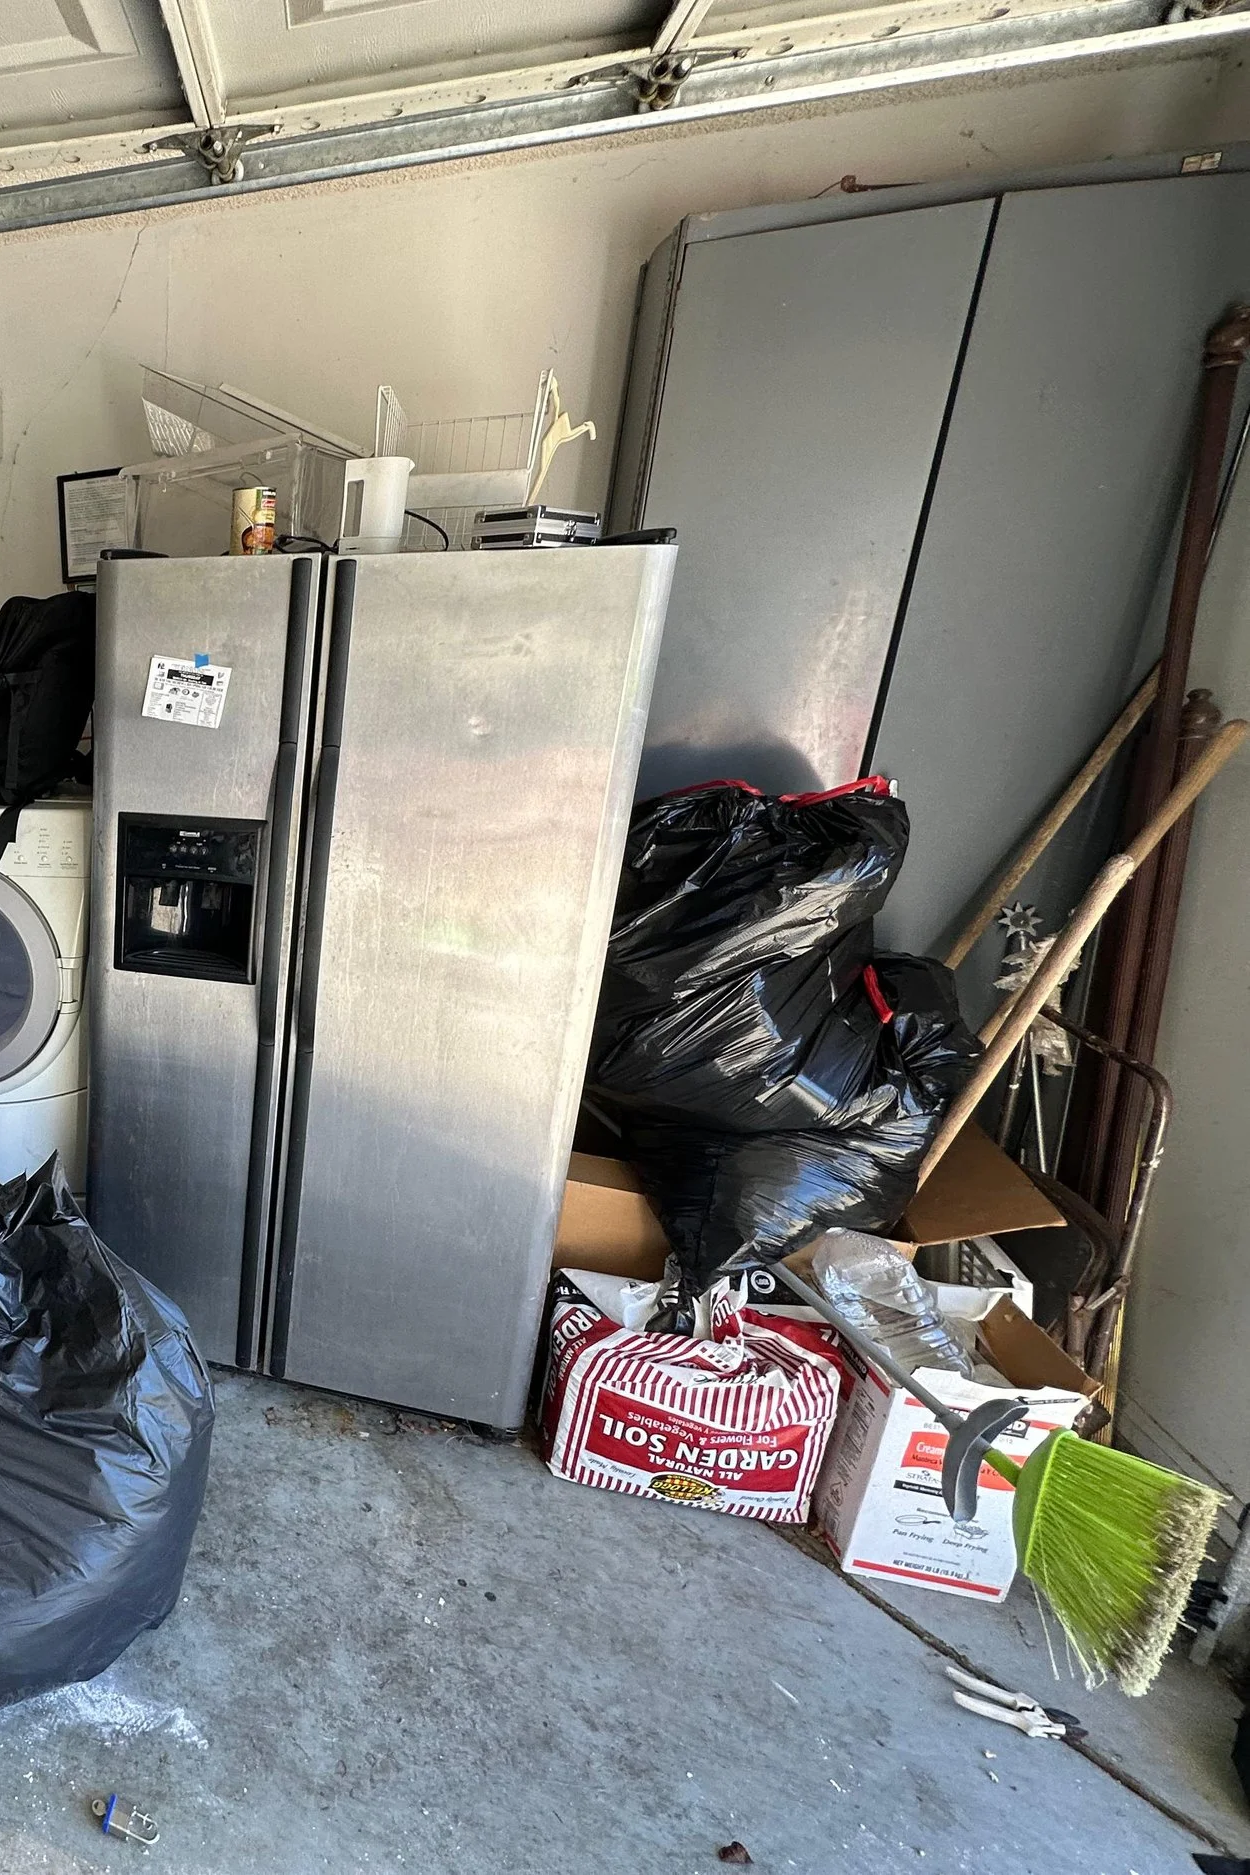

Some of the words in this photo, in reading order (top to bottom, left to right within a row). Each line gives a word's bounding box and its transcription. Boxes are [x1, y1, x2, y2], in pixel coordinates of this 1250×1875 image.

[627, 1411, 694, 1442] Vegetables
[668, 1416, 703, 1433] vegetales
[599, 1413, 667, 1453] SOIL
[698, 1436, 708, 1446] &
[710, 1435, 753, 1446] Flowers
[756, 1435, 778, 1448] For
[675, 1441, 799, 1471] GARDEN
[588, 1458, 609, 1469] Made
[647, 1453, 715, 1478] NATURAL
[609, 1465, 636, 1478] Locally
[718, 1471, 744, 1481] ALL
[652, 1481, 714, 1495] KELLOGG
[892, 1528, 907, 1537] Pan
[908, 1531, 935, 1543] Frying
[942, 1538, 963, 1548] Deep
[963, 1542, 989, 1554] Frying
[904, 1561, 925, 1571] WEIGHT
